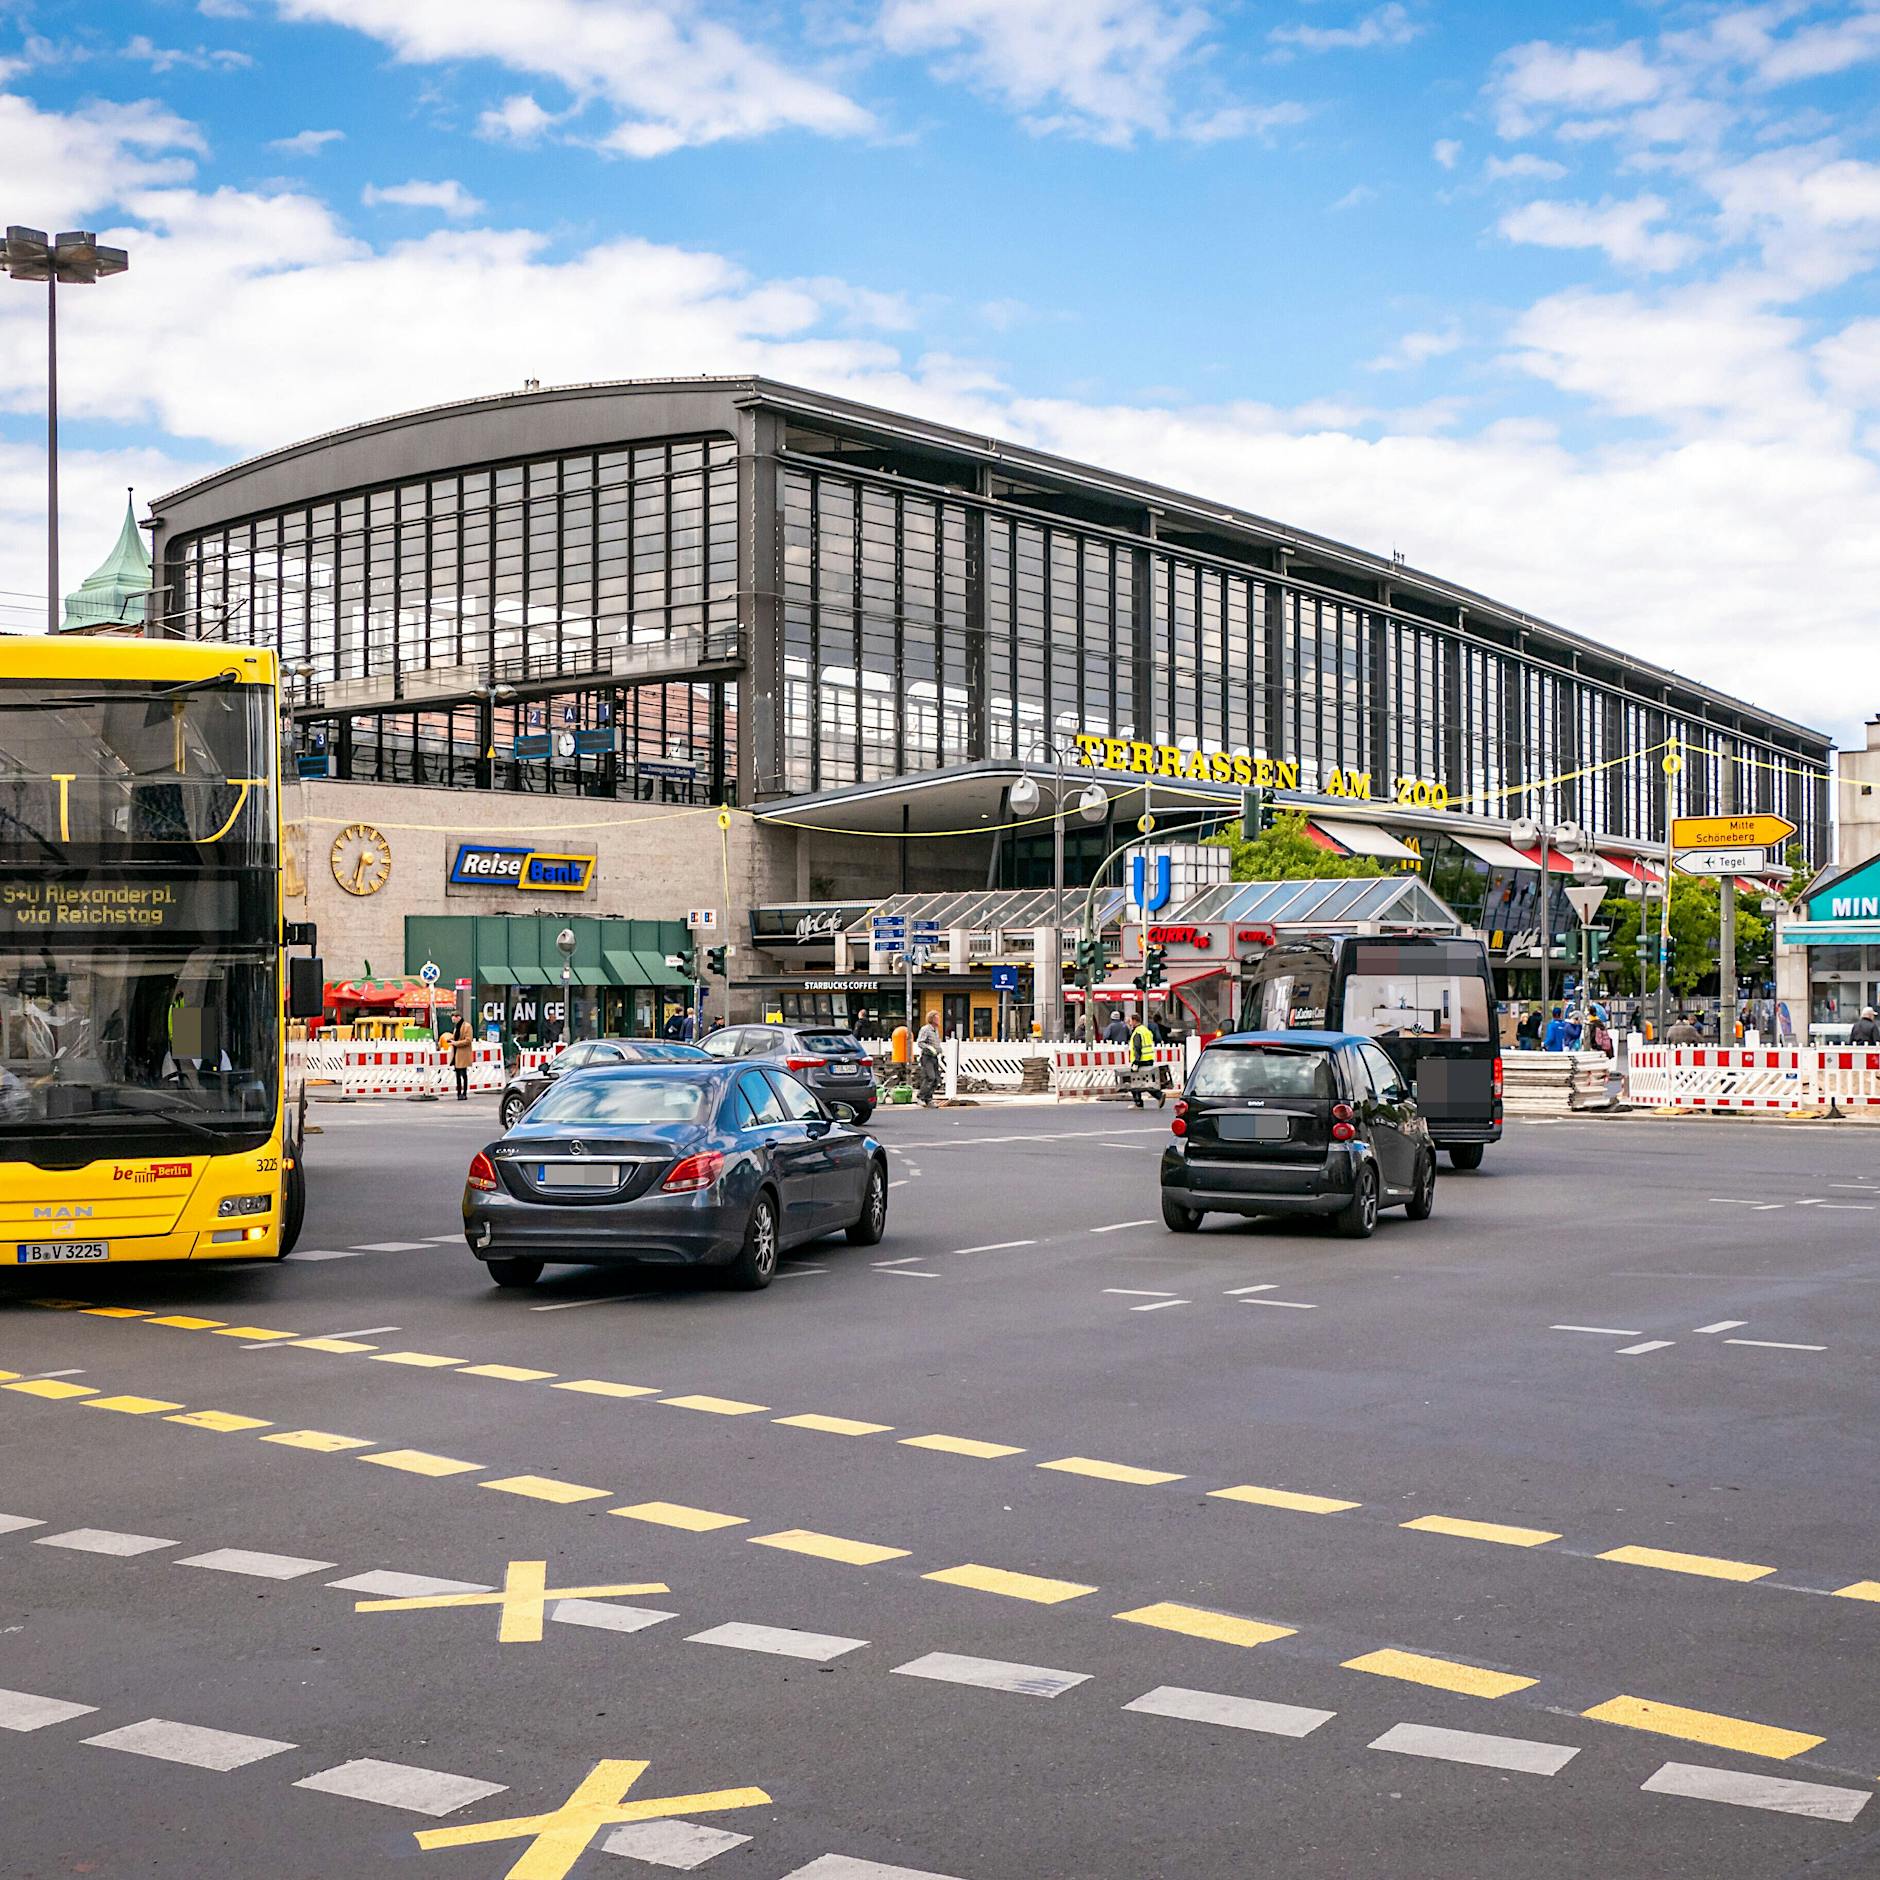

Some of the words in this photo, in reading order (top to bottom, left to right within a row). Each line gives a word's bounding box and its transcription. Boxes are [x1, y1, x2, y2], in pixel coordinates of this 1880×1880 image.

[531, 712, 537, 723] 2
[566, 708, 573, 720] A
[319, 733, 324, 745] 3
[1076, 734, 1299, 790] TERRASSEN
[1326, 768, 1372, 799] AM
[1397, 777, 1448, 810] ZOO
[1730, 821, 1754, 830] Mitte
[1696, 832, 1755, 843] Schöneberg
[462, 853, 521, 875] Reise
[529, 861, 582, 883] Bank
[1720, 857, 1746, 868] Tegel
[1134, 855, 1171, 912] U
[3, 885, 40, 904] S+U
[46, 885, 177, 905] Alexanderpl.
[17, 905, 50, 922] via
[57, 904, 163, 925] Reichstag
[1148, 926, 1197, 943] CURRY
[804, 981, 848, 990] STARBUCKS
[848, 981, 878, 990] COFFEE
[256, 1158, 278, 1172] 3225
[113, 1166, 133, 1180] be
[158, 1165, 188, 1177] Berlin
[33, 1205, 93, 1218] MAN
[32, 1246, 42, 1260] B
[53, 1245, 62, 1259] V
[65, 1243, 103, 1259] 3225
